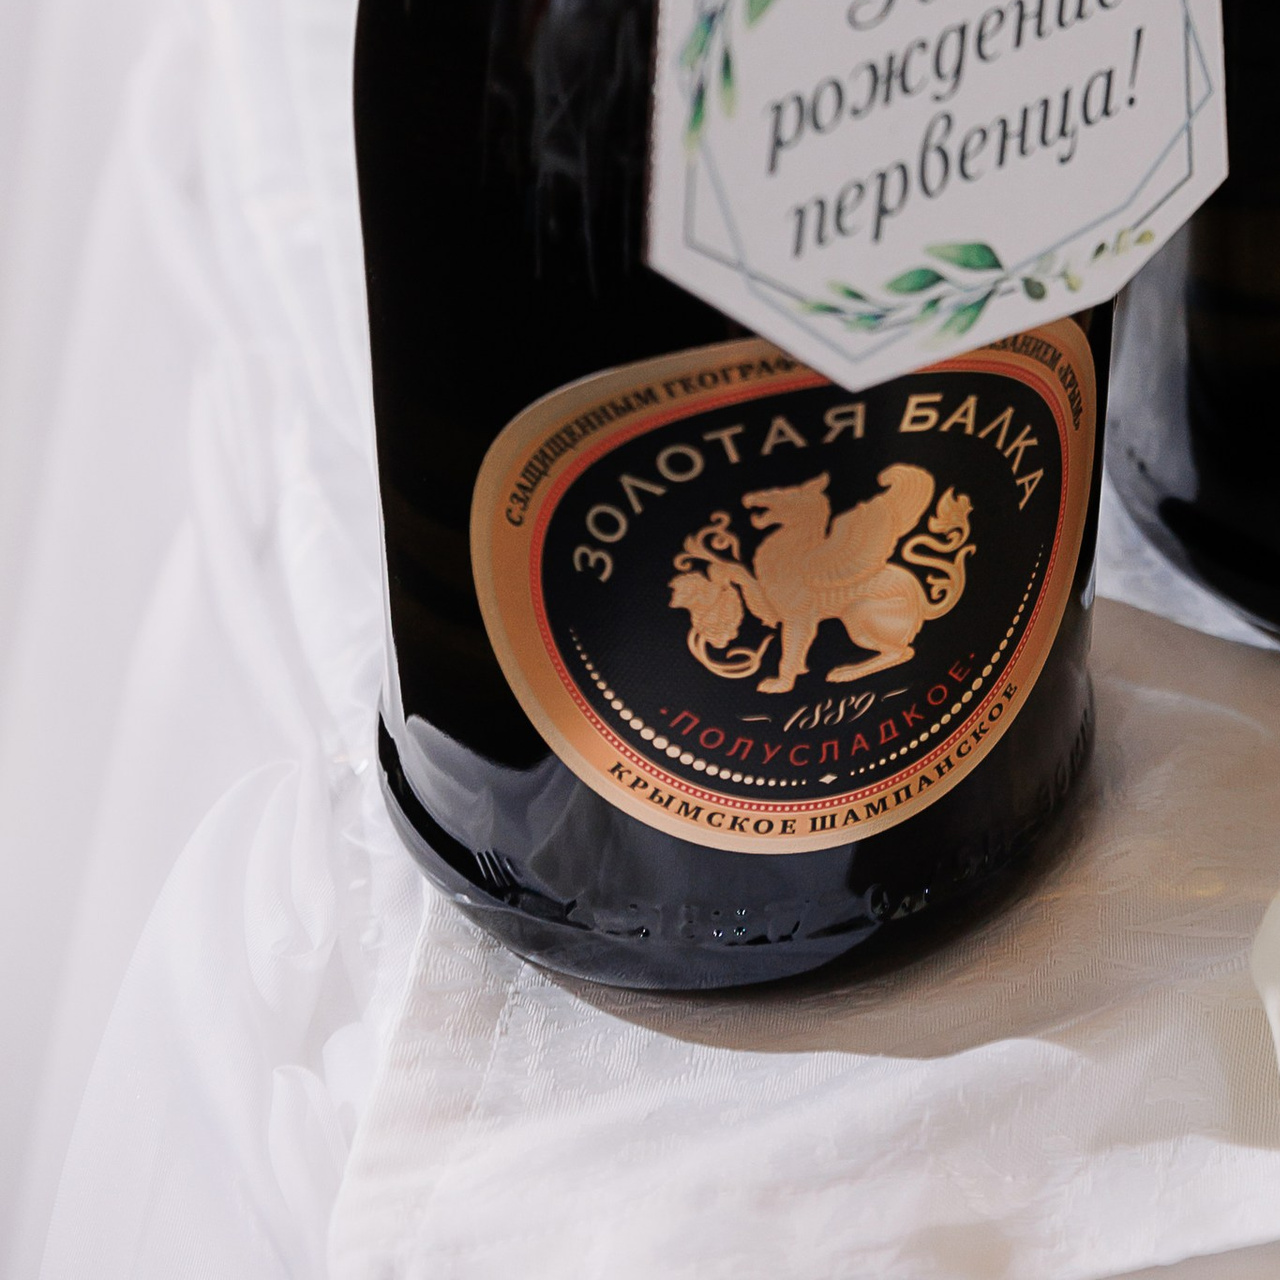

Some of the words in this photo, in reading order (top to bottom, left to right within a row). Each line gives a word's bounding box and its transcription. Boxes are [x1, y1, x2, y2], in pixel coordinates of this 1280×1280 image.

[791, 26, 1145, 259] первенца!
[573, 403, 865, 582] ЗОЛОТАЯ
[900, 393, 1044, 510] БАЛКА
[606, 760, 797, 836] КРЫМСКОЕ
[809, 682, 1018, 833] ШАМПАНСКОЕ
[668, 661, 972, 767] ПОЛУСЛАДКОЕ
[783, 691, 876, 732] 1889
